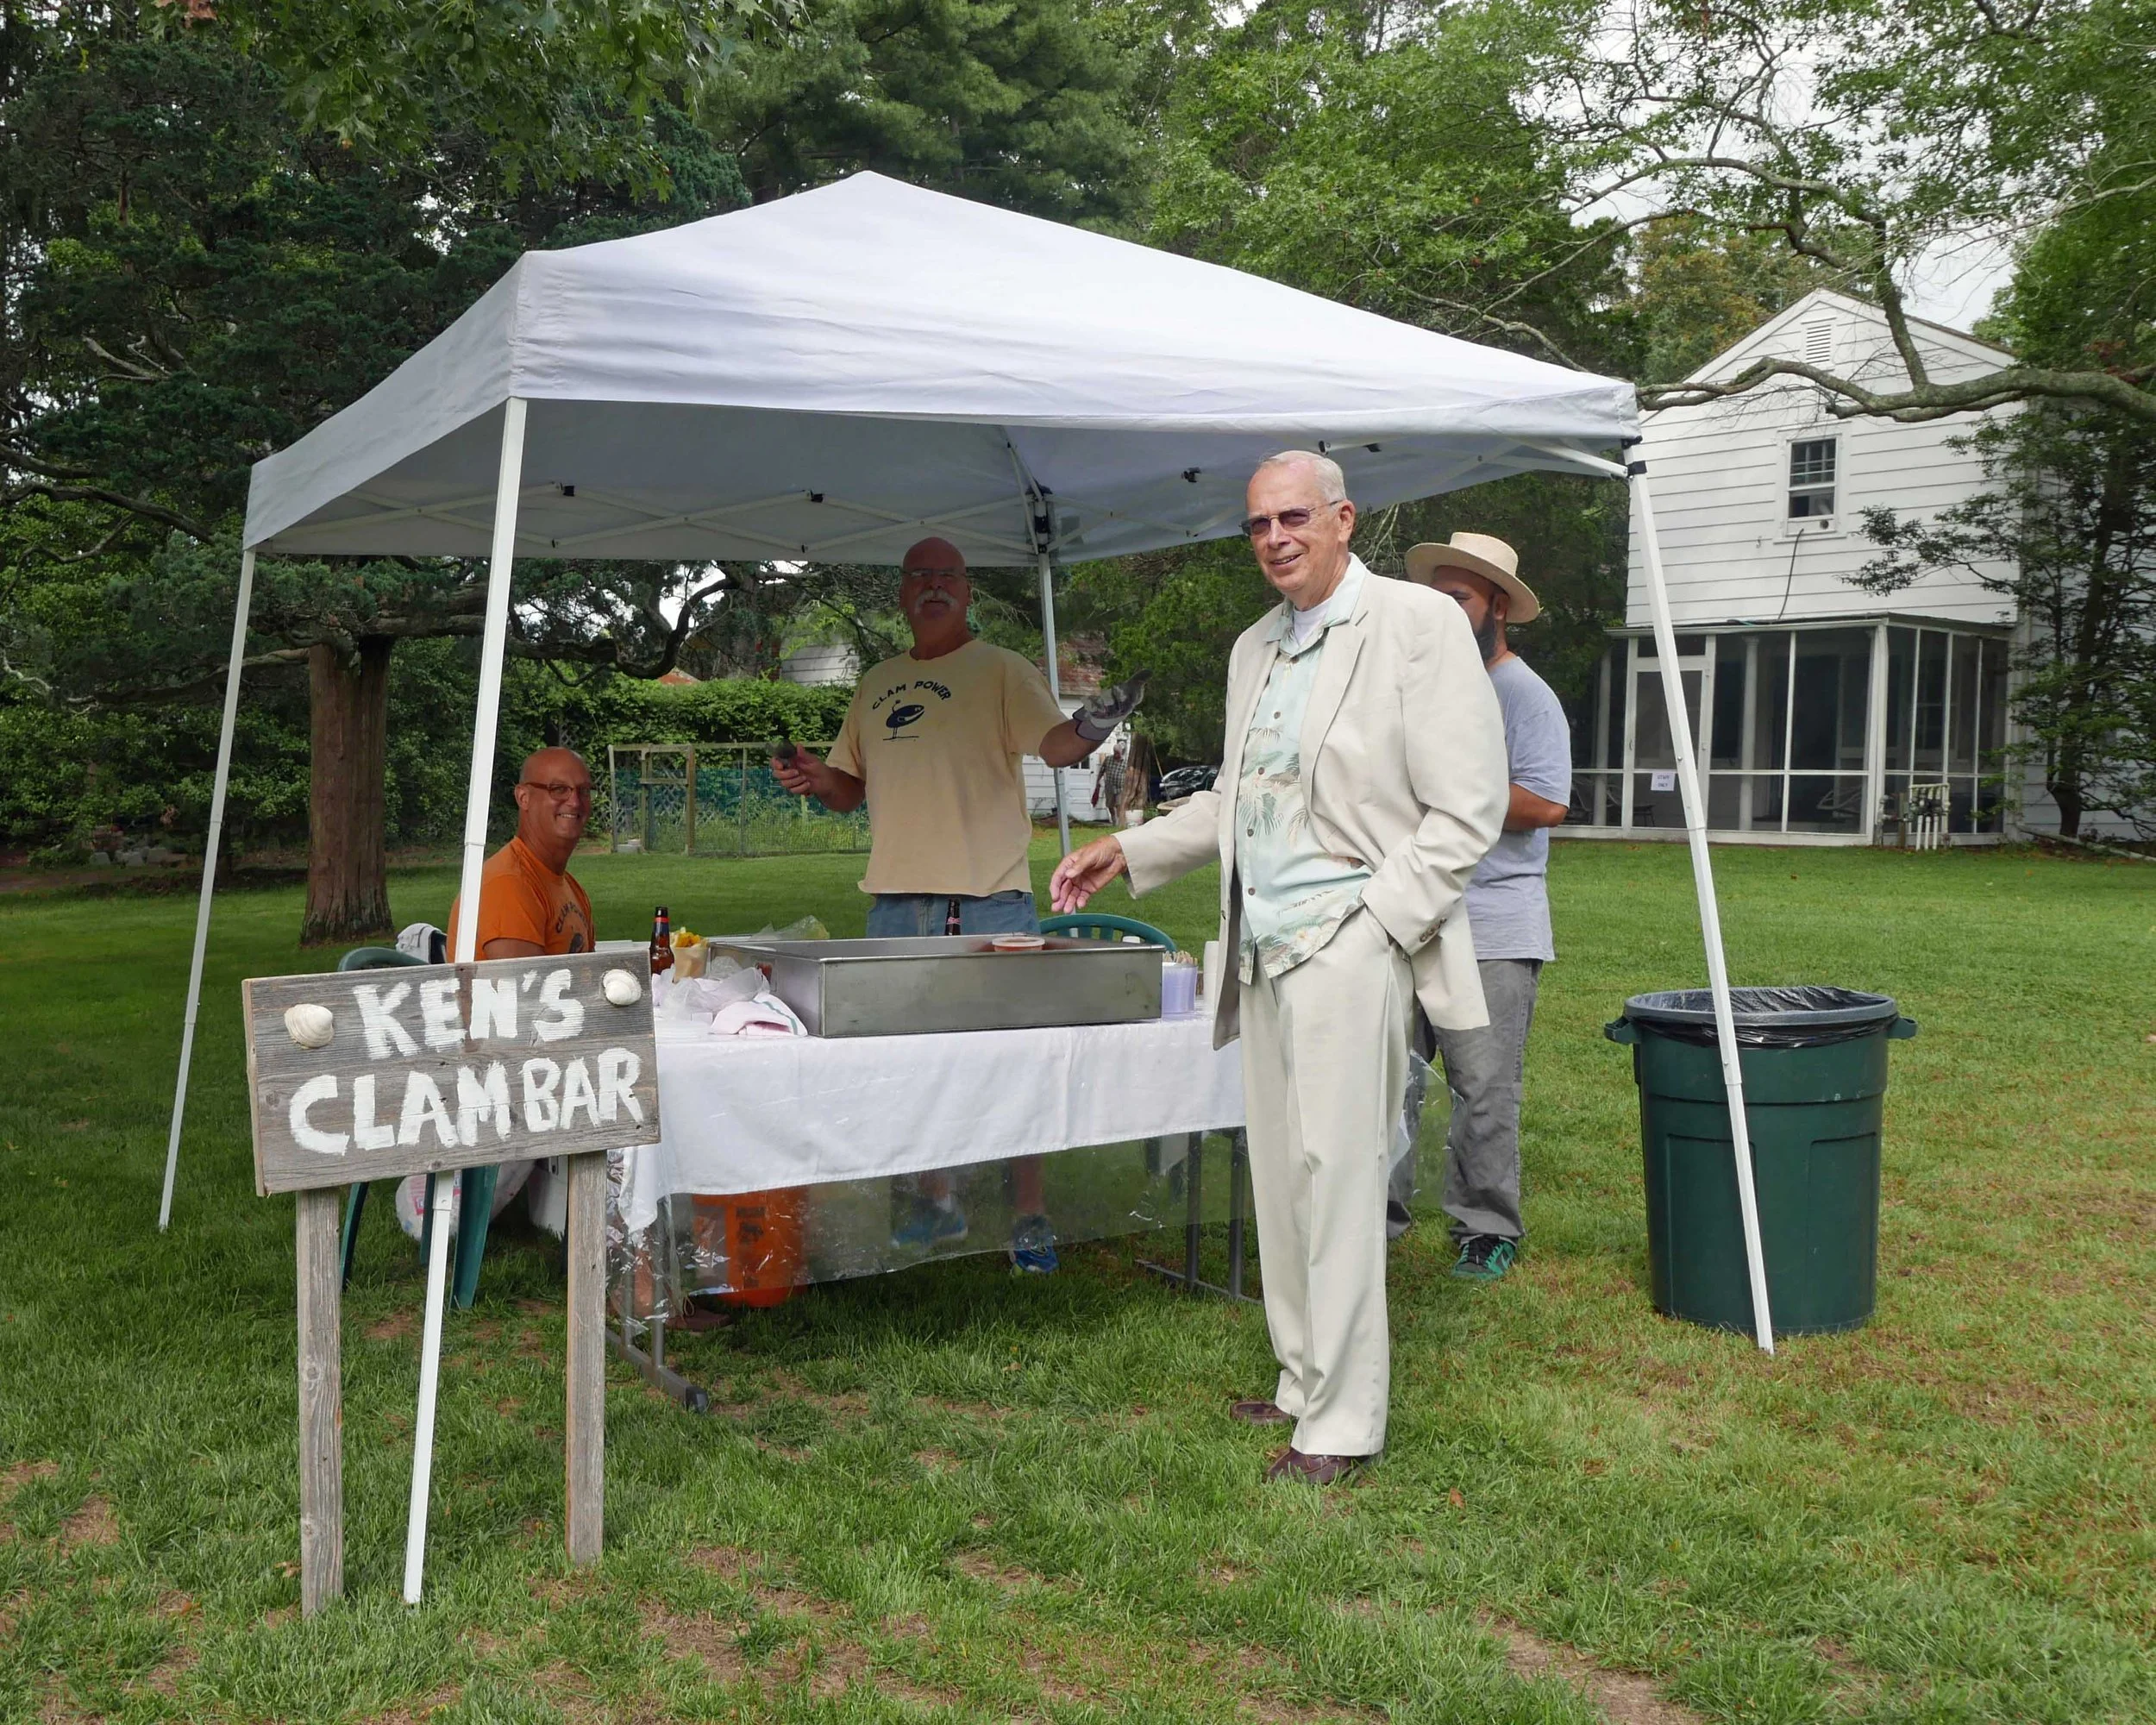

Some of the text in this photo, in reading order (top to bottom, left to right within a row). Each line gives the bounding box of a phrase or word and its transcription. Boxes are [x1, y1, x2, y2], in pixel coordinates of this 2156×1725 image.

[872, 681, 952, 710] CLAM POWER
[353, 968, 586, 1060] KEN'S
